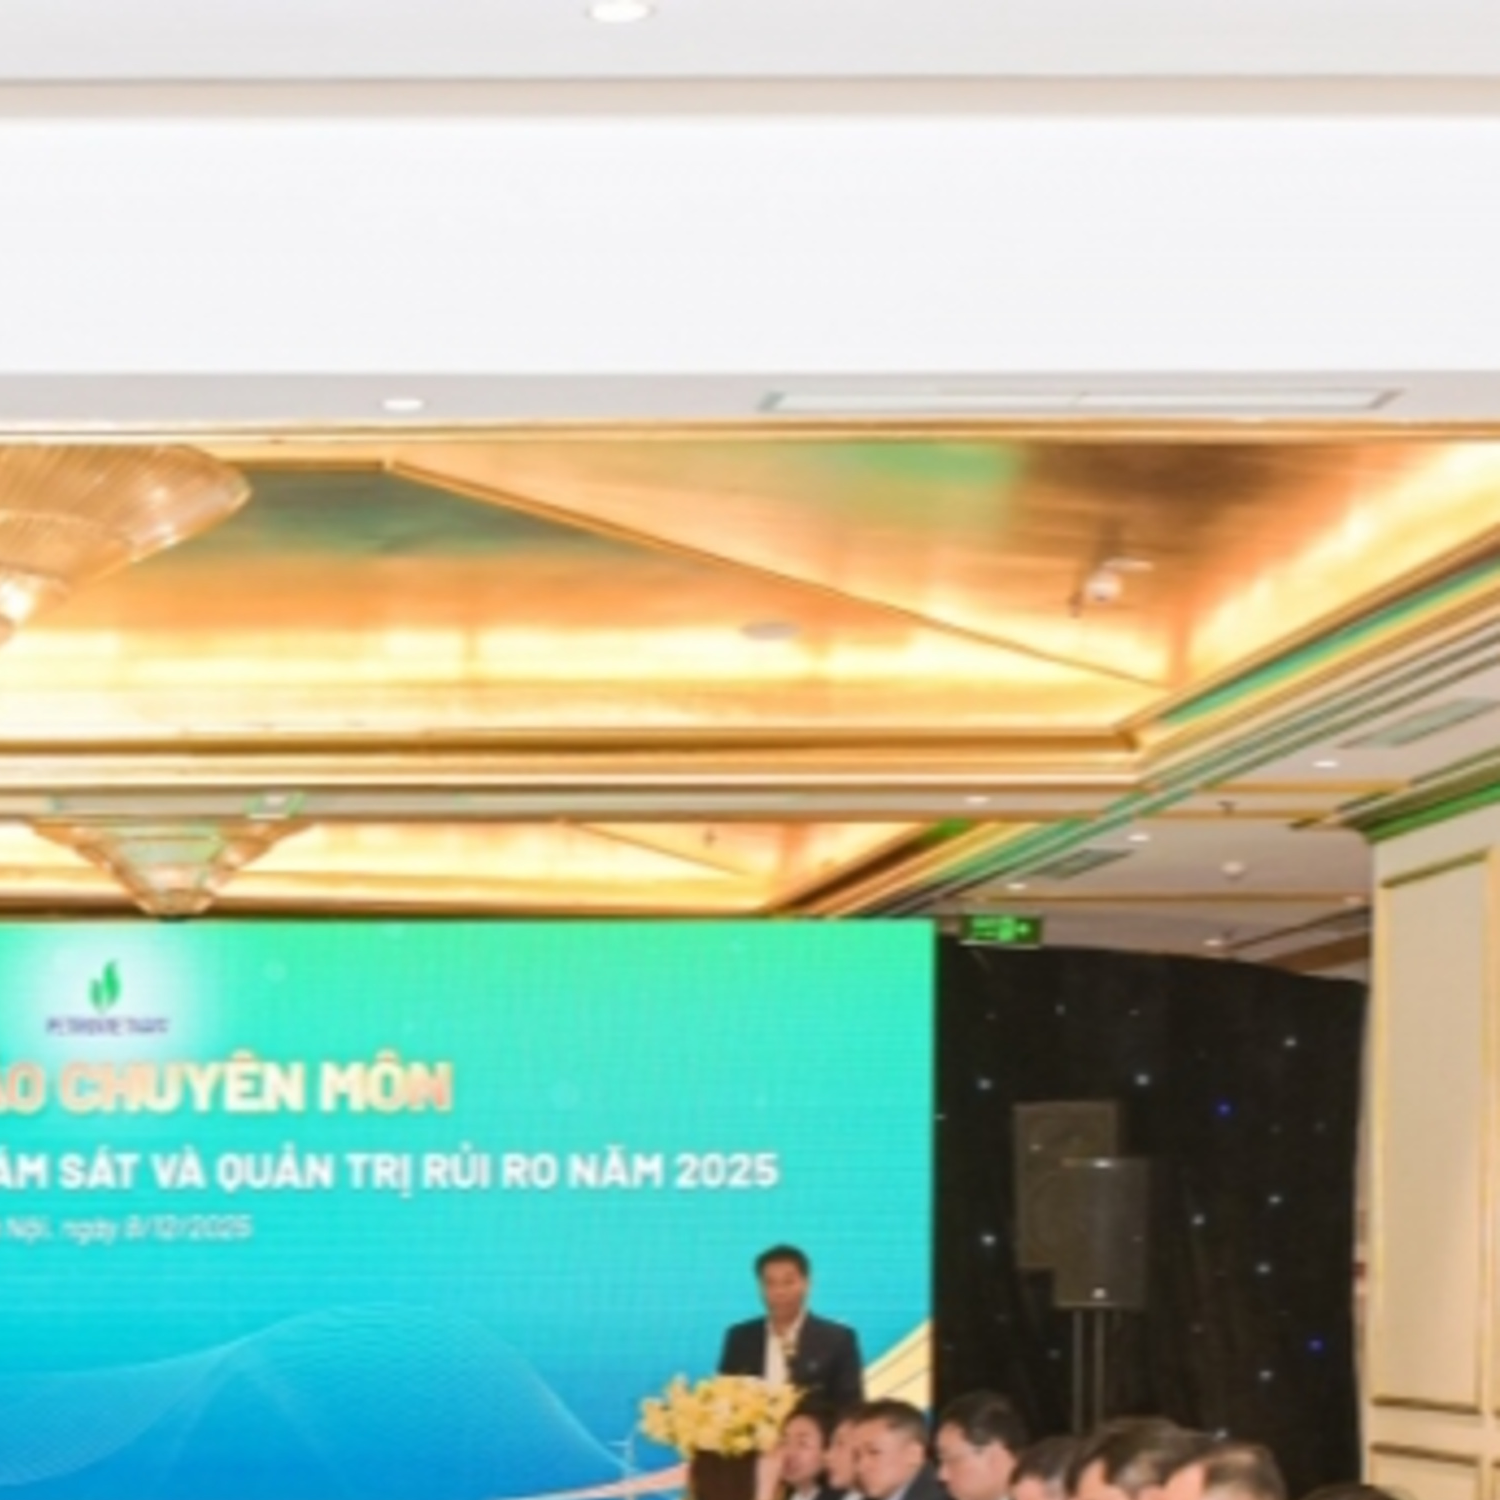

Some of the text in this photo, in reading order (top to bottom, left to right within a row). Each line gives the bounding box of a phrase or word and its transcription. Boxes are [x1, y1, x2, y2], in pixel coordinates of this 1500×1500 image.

[60, 1048, 306, 1114] CHUYÊN
[319, 1048, 453, 1113] MÔN
[59, 1144, 141, 1190] SÁT
[148, 1144, 207, 1190] VÀ
[217, 1141, 334, 1195] QUẢN
[344, 1153, 412, 1199] TRỊ
[501, 1153, 558, 1190] RO
[567, 1144, 665, 1190] NĂM
[674, 1153, 780, 1190] 2025
